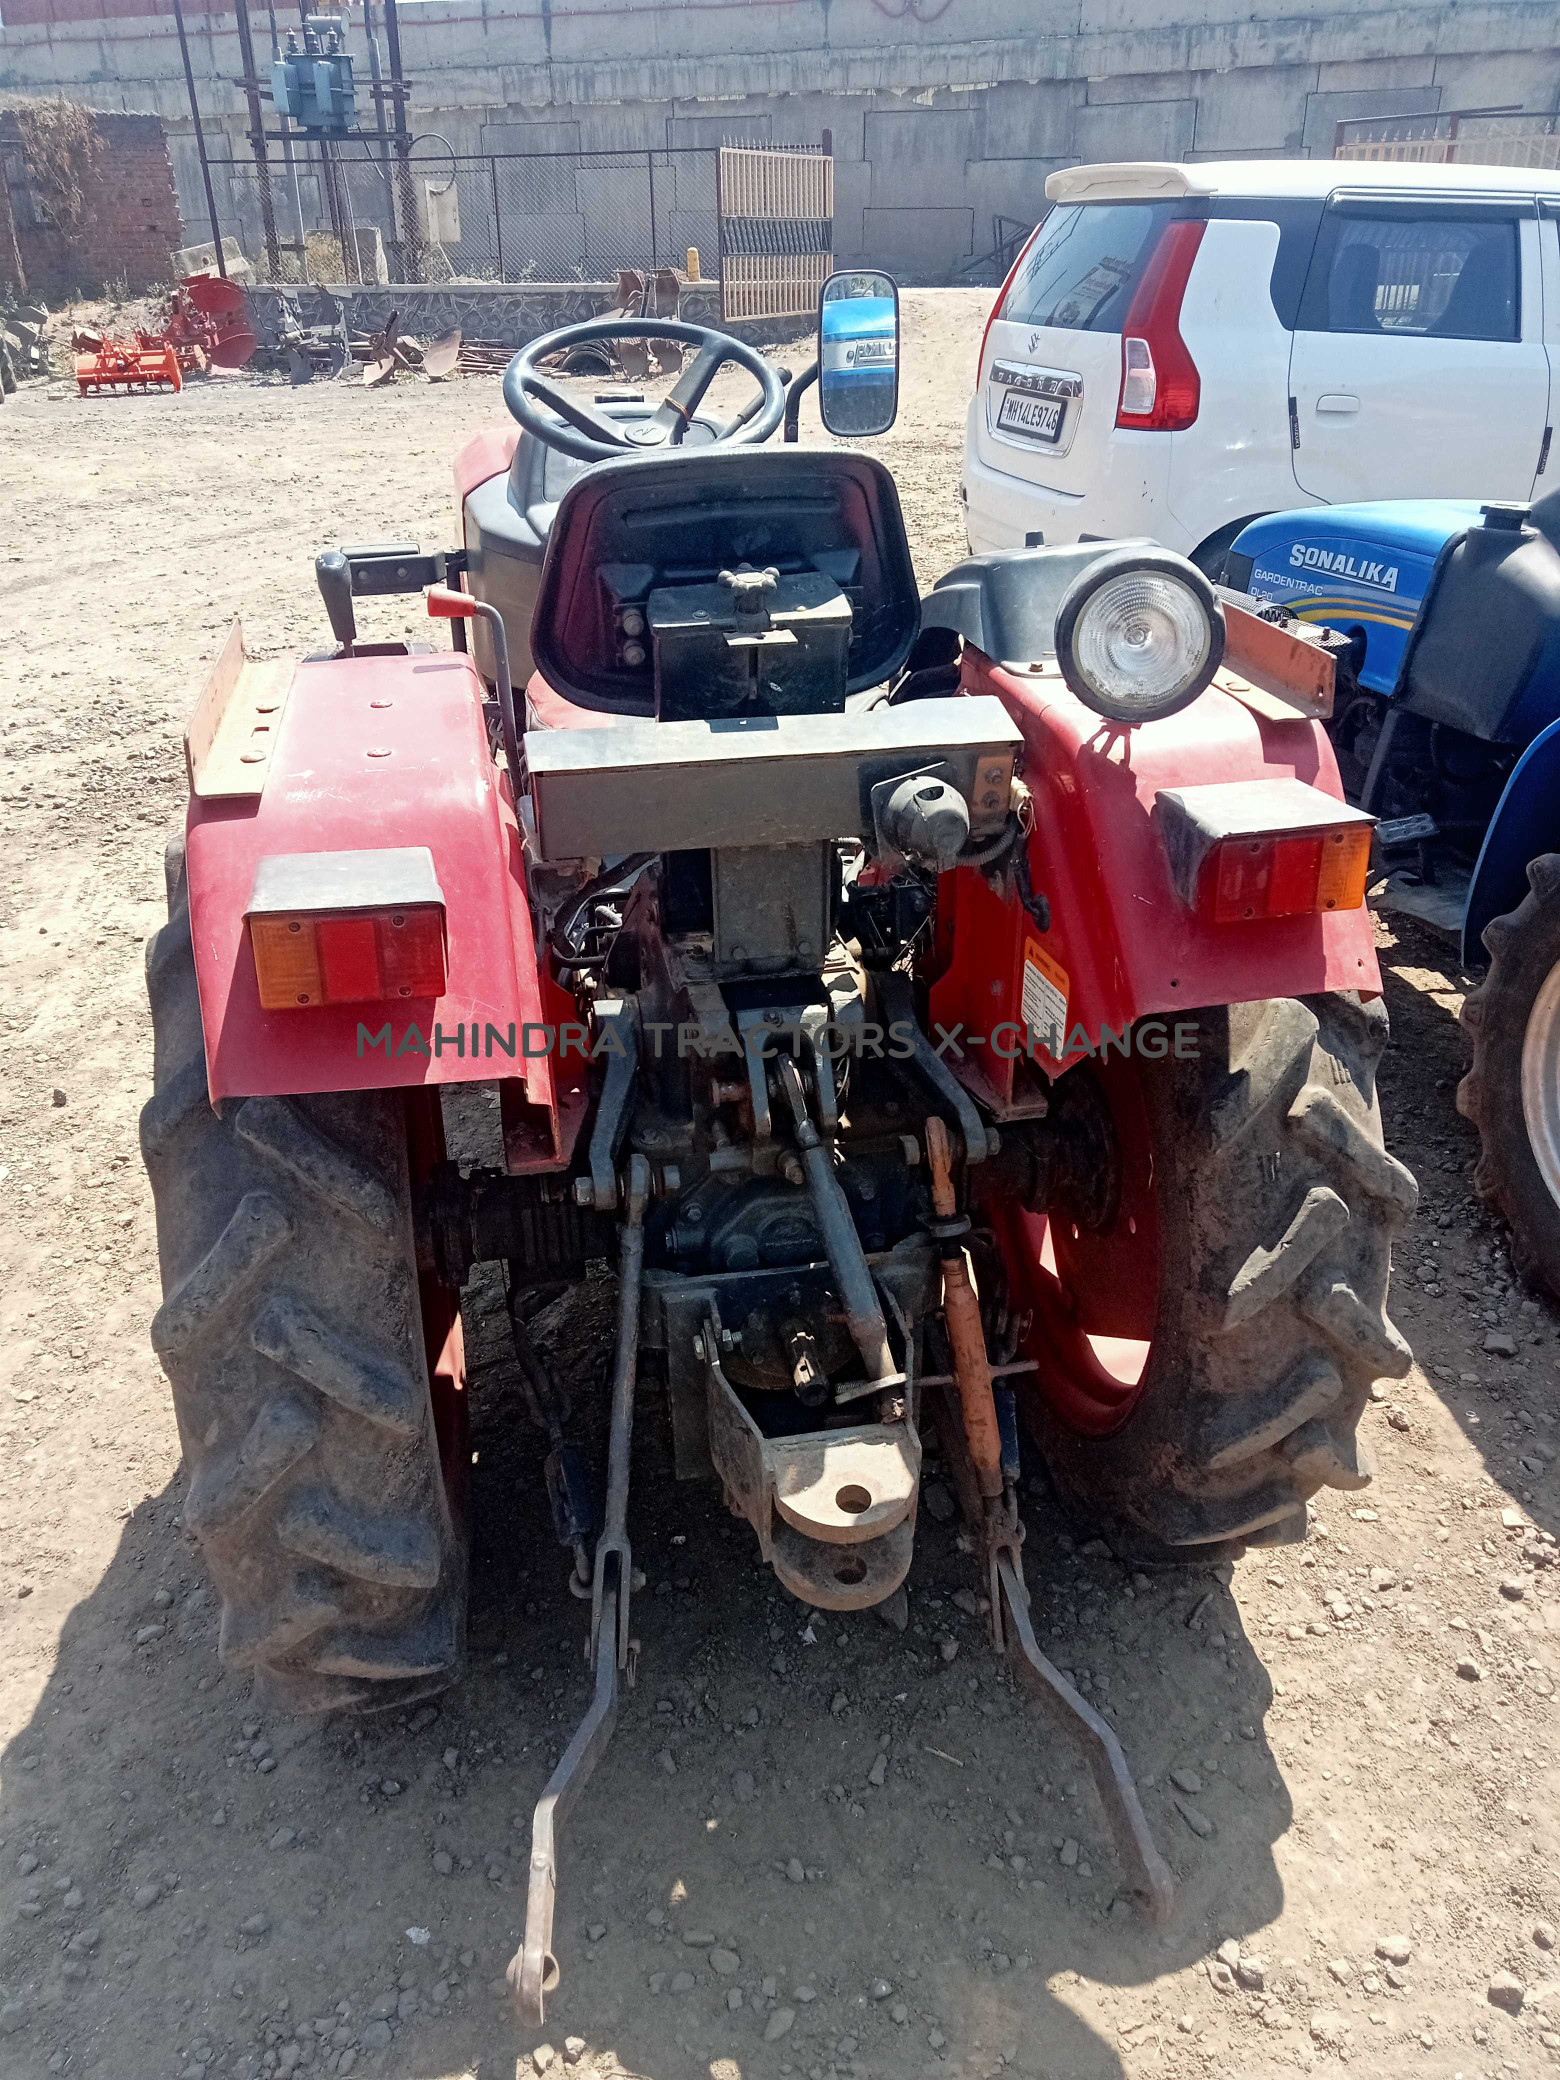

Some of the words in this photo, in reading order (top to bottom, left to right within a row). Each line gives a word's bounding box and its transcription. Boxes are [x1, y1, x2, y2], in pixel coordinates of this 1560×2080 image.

[1006, 399, 1059, 431] MH14LE9746
[1254, 568, 1324, 596] GARDENTRAC
[1289, 543, 1399, 593] SONALIKA
